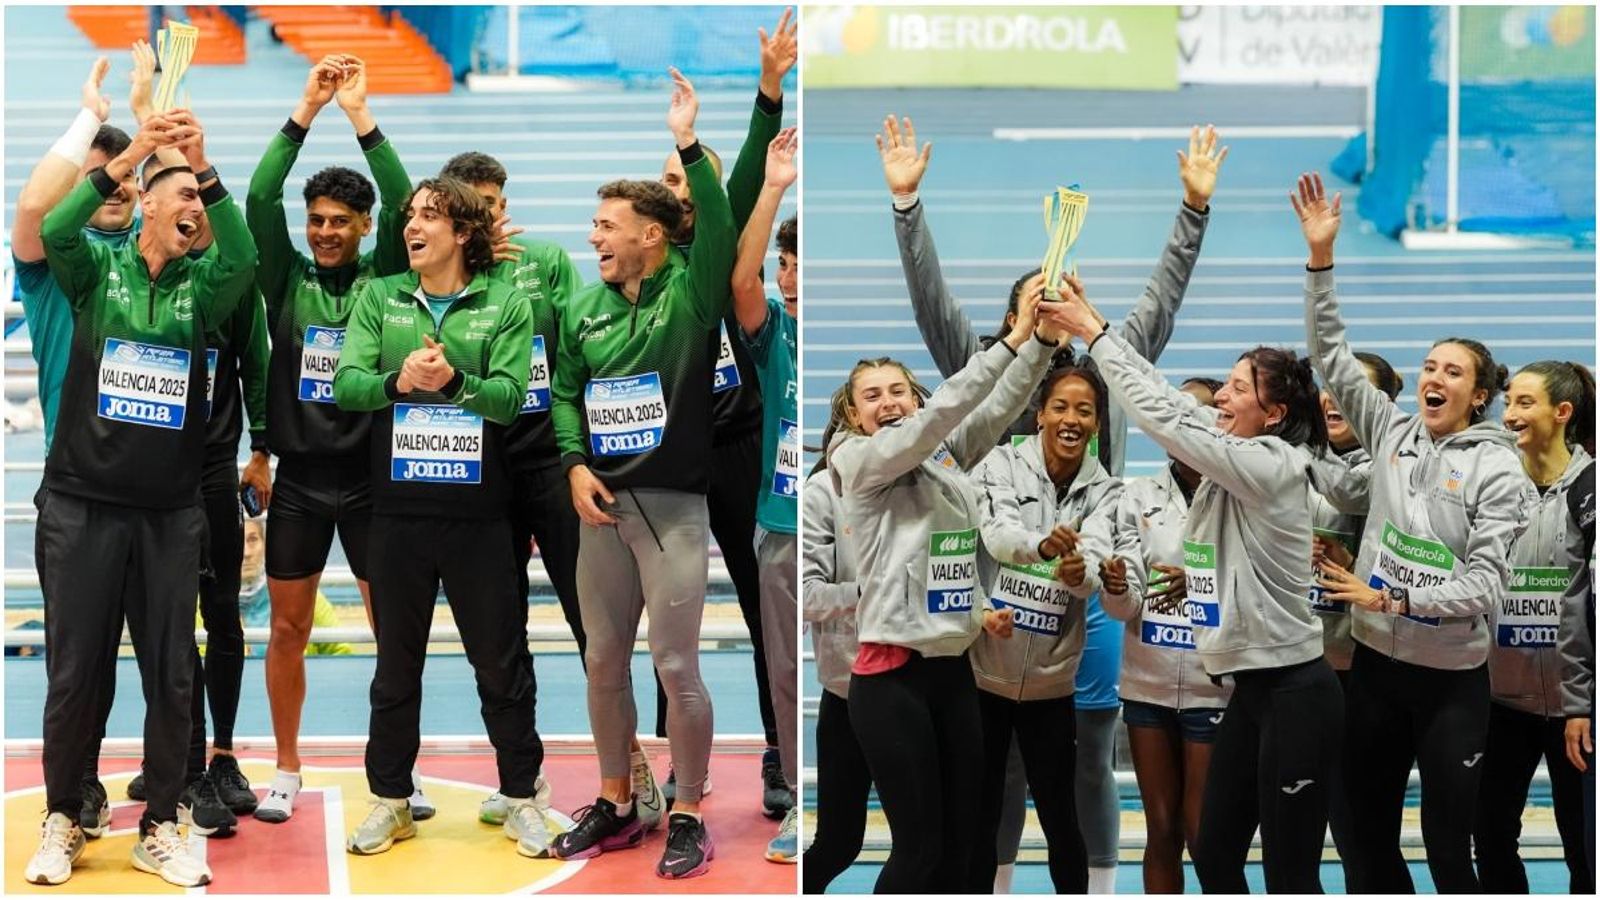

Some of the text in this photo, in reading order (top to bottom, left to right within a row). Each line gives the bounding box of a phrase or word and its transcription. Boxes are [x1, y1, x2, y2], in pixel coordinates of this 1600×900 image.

[888, 13, 1127, 53] IBERDROLA
[102, 368, 156, 394] VALENCIA
[159, 377, 186, 398] 2025
[588, 402, 663, 426] VALENCIA 2025
[395, 433, 479, 453] VALENCIA 2025
[1396, 538, 1446, 564] Iberdrola
[931, 562, 974, 581] VALENC
[1528, 574, 1570, 587] Iberdro
[1000, 574, 1052, 604] VALENCIA
[1012, 606, 1060, 632] oma
[1501, 598, 1558, 616] VALENCIA
